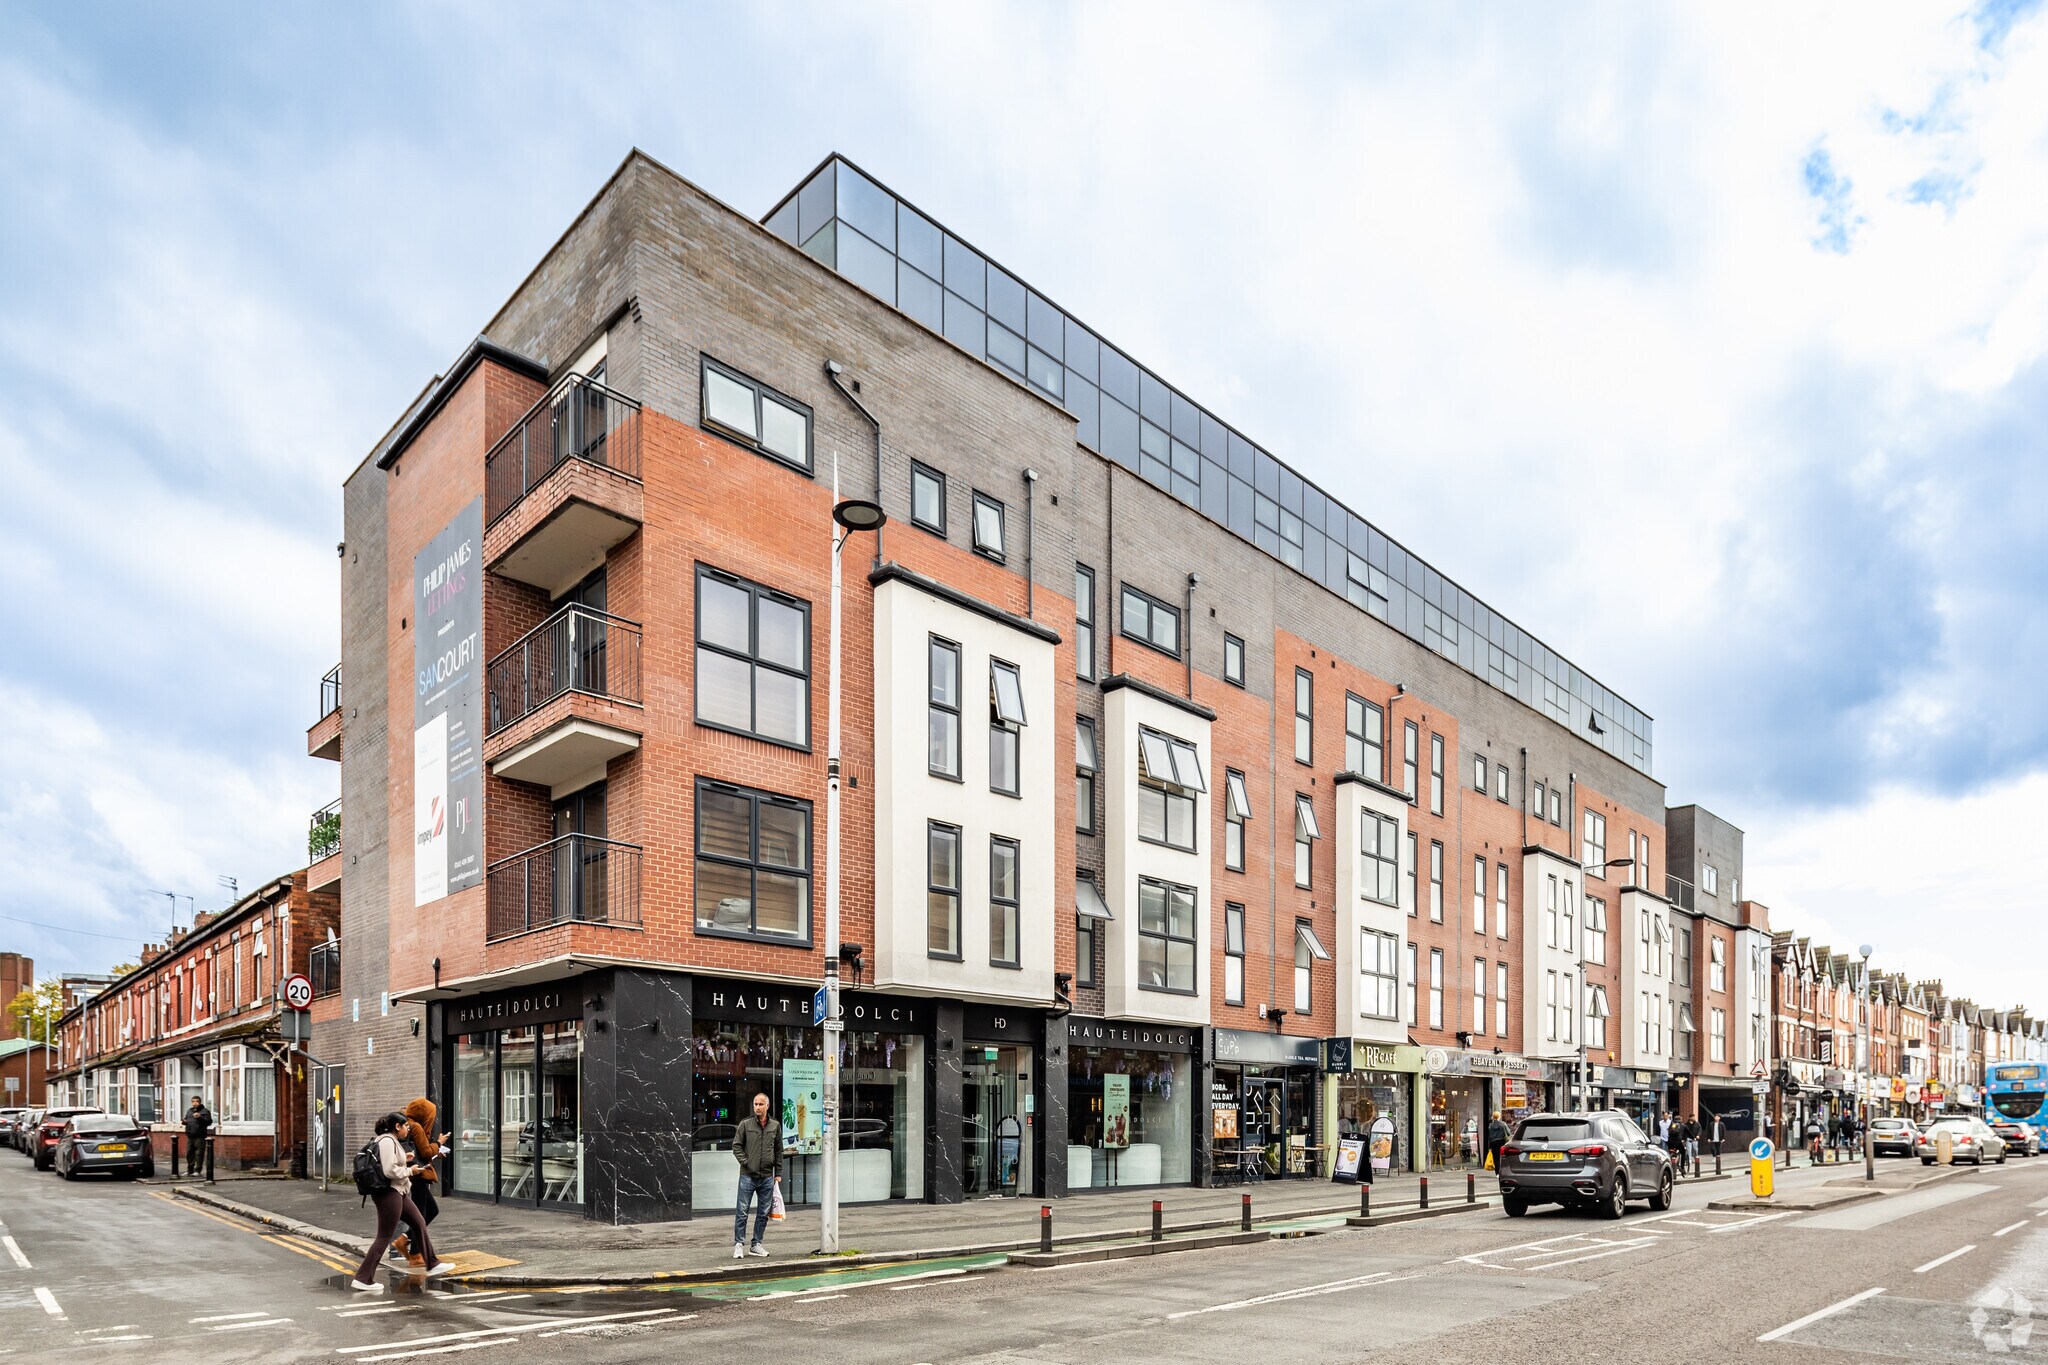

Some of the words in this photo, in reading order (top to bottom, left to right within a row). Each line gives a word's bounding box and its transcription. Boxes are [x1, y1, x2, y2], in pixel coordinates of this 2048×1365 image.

[423, 563, 446, 598] PHILIP
[446, 538, 472, 584] JAMES
[427, 571, 466, 616] LETTINGS
[419, 632, 477, 695] SANCOURT
[290, 985, 310, 1000] 20
[460, 1003, 502, 1022] HAUTE
[513, 993, 560, 1014] DOLCI
[713, 992, 809, 1015] HAUTE
[994, 1017, 1007, 1029] HD
[1069, 1025, 1128, 1040] HAUTE
[1143, 1032, 1193, 1046] DOLCI
[1366, 1046, 1380, 1067] RF
[1473, 1057, 1502, 1068] HEAVENLY
[1503, 1061, 1530, 1070] DESSERTS
[560, 1107, 570, 1119] HD
[1212, 1102, 1241, 1110] EVERYDAY.
[972, 1155, 984, 1166] HD
